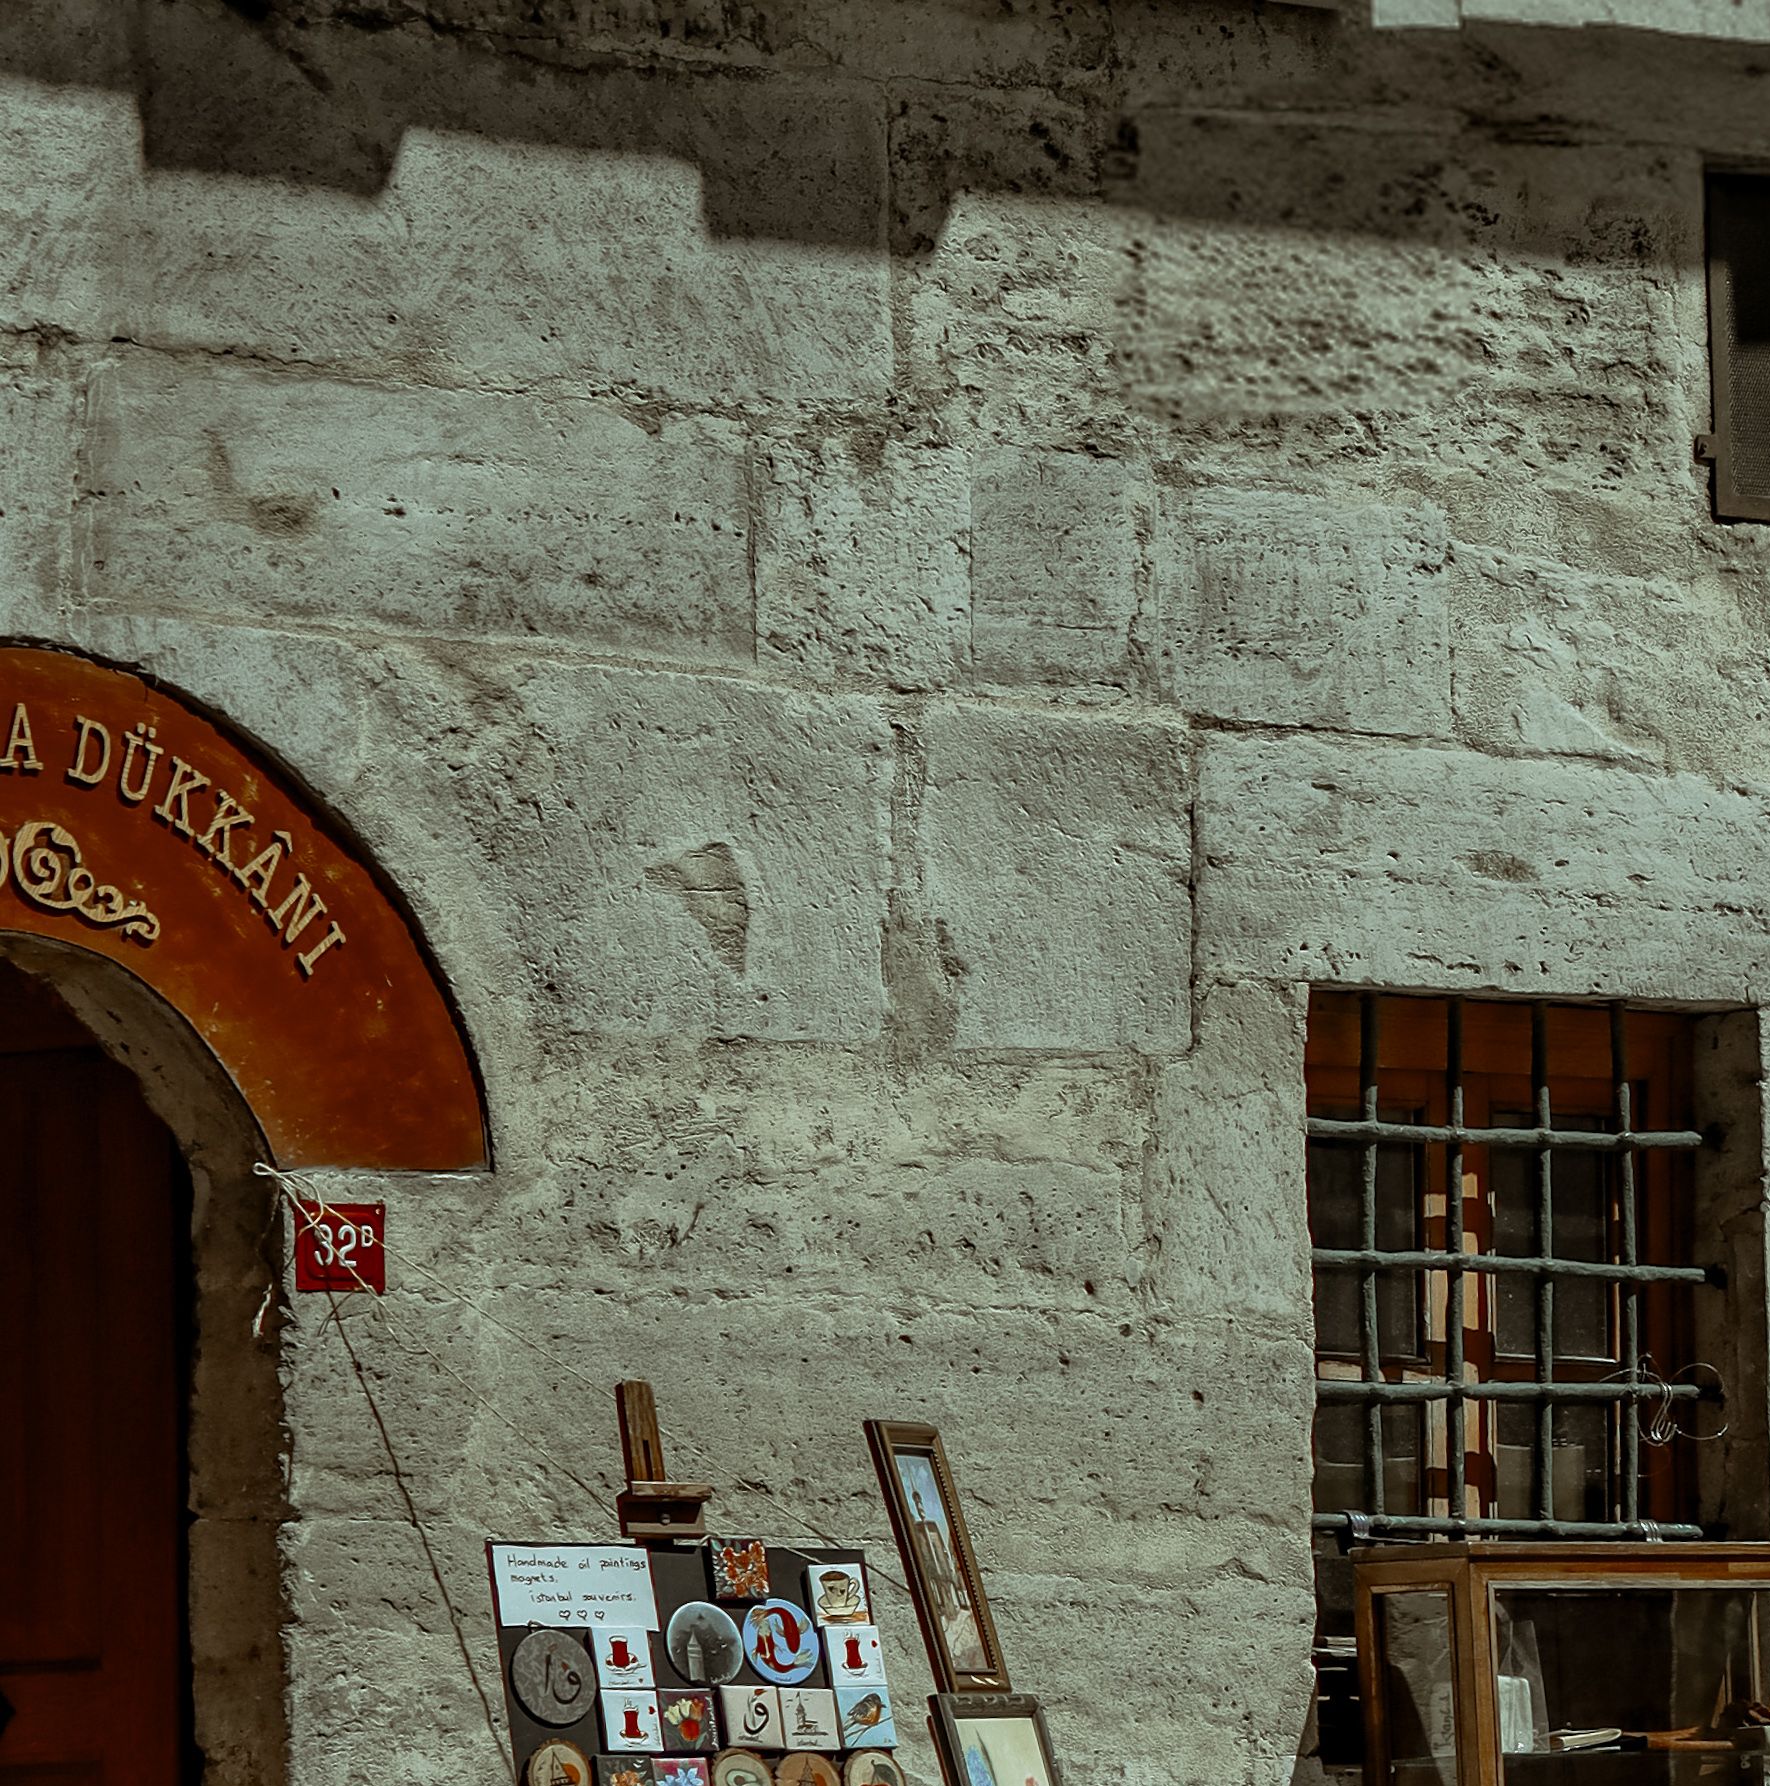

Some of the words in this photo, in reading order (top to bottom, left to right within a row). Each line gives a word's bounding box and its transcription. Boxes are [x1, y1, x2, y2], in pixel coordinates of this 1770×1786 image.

[67, 714, 346, 976] DÜKKÂNI
[507, 1554, 569, 1568] Handmade
[578, 1558, 591, 1570] oil
[599, 1557, 646, 1571] paintings
